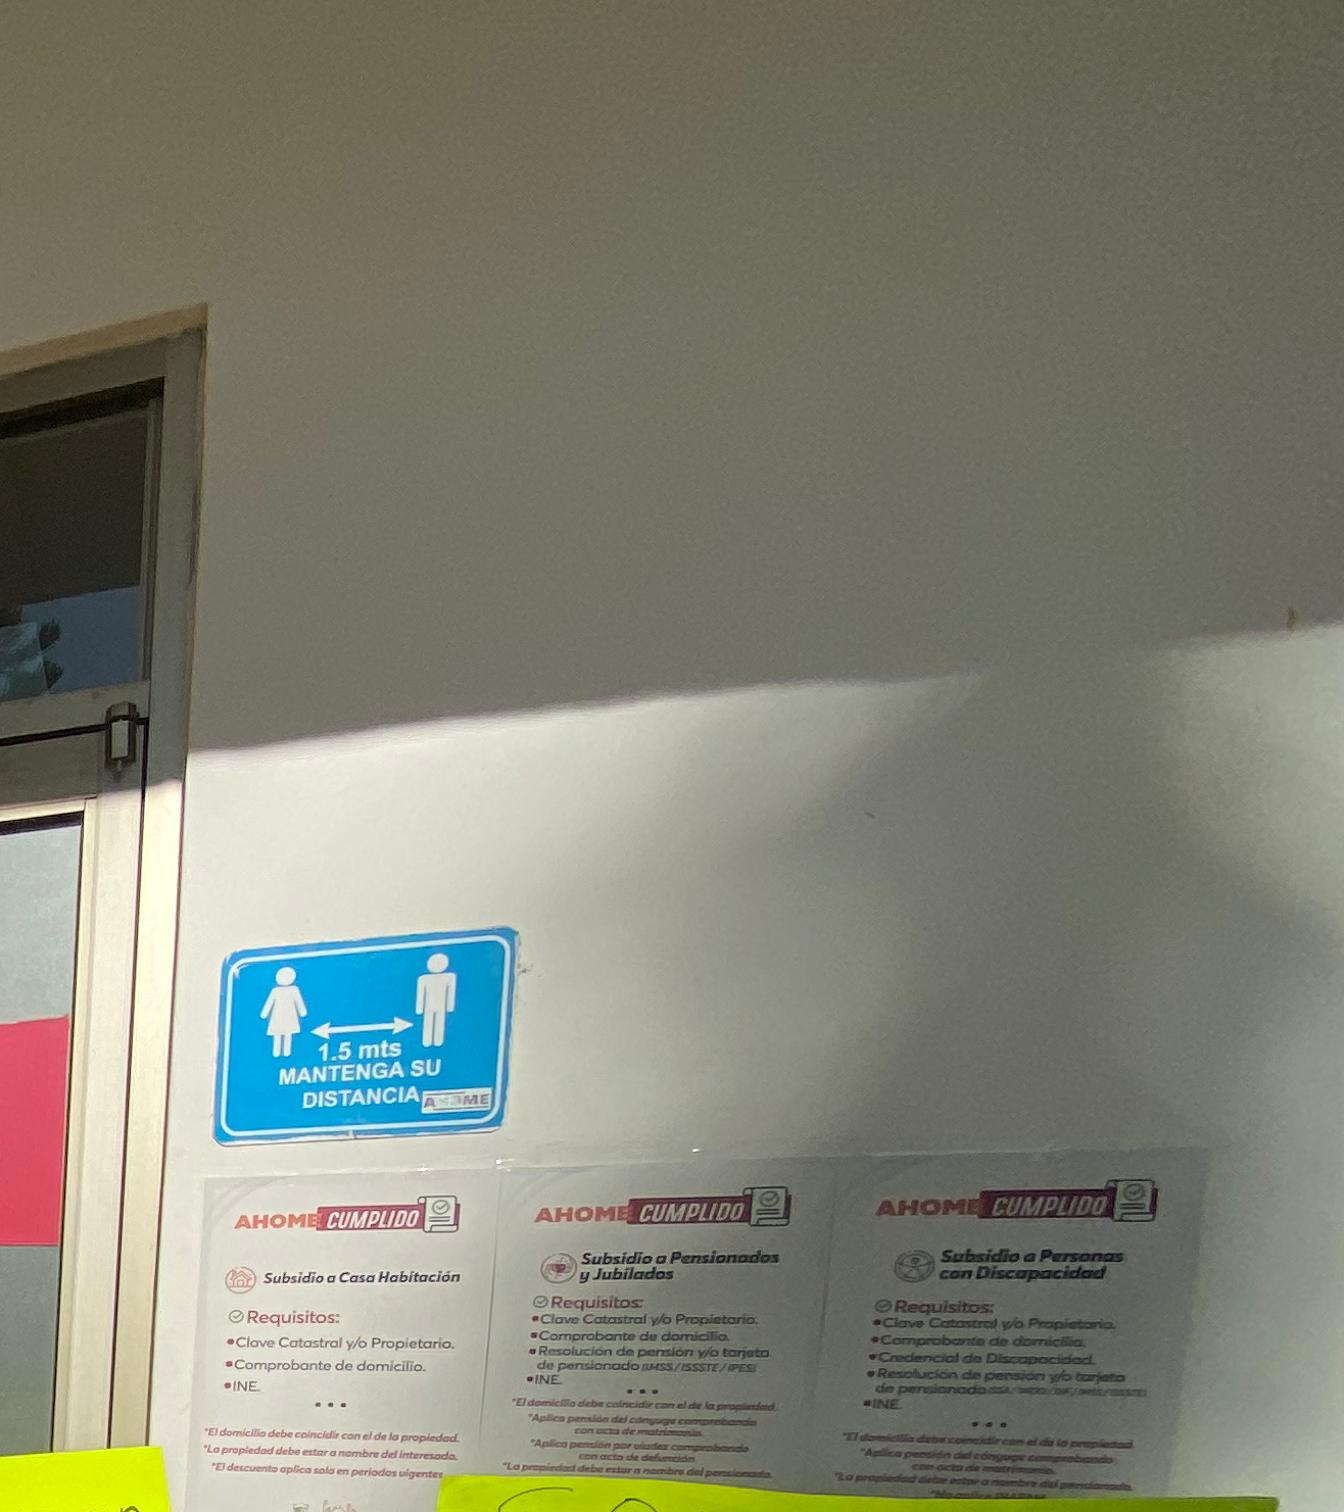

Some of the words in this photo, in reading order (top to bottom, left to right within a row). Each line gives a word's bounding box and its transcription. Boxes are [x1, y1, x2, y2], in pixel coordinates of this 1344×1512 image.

[318, 1041, 352, 1062] 1.5
[358, 1039, 402, 1059] mts
[279, 1061, 405, 1086] MANTENGA
[409, 1058, 442, 1078] SU
[302, 1085, 420, 1110] DISTANCIA
[534, 1206, 630, 1223] AHOME
[639, 1202, 745, 1222] CUMPLIDO
[875, 1198, 980, 1216] AHOME
[991, 1195, 1108, 1217] CUMPLIDO
[234, 1213, 318, 1230] AHOME
[326, 1209, 419, 1229] CUMPLIDO
[581, 1251, 653, 1265] Subsidio
[656, 1254, 667, 1265] a
[670, 1249, 780, 1265] Pensionados
[941, 1249, 1019, 1264] Subsidio
[1024, 1253, 1036, 1263] a
[1040, 1250, 1123, 1263] Personas
[264, 1271, 325, 1284] Subsidio
[326, 1274, 336, 1284] a
[339, 1271, 375, 1284] Casa
[378, 1269, 461, 1284] Habitación
[579, 1270, 589, 1283] y
[592, 1267, 673, 1281] Jubilados
[939, 1267, 972, 1279] con
[976, 1265, 1105, 1282] Discapacidad
[551, 1296, 644, 1312] Requisitos:
[894, 1299, 994, 1315] Requisitos:
[247, 1309, 340, 1328] Requisitos:
[236, 1336, 275, 1349] Clave
[278, 1336, 342, 1349] Catastral
[346, 1337, 367, 1351] y/o
[371, 1337, 455, 1353] Propietario.
[234, 1359, 331, 1373] Comprobante
[335, 1359, 353, 1371] de
[357, 1359, 426, 1372] domicilio.
[268, 1429, 294, 1439] debe
